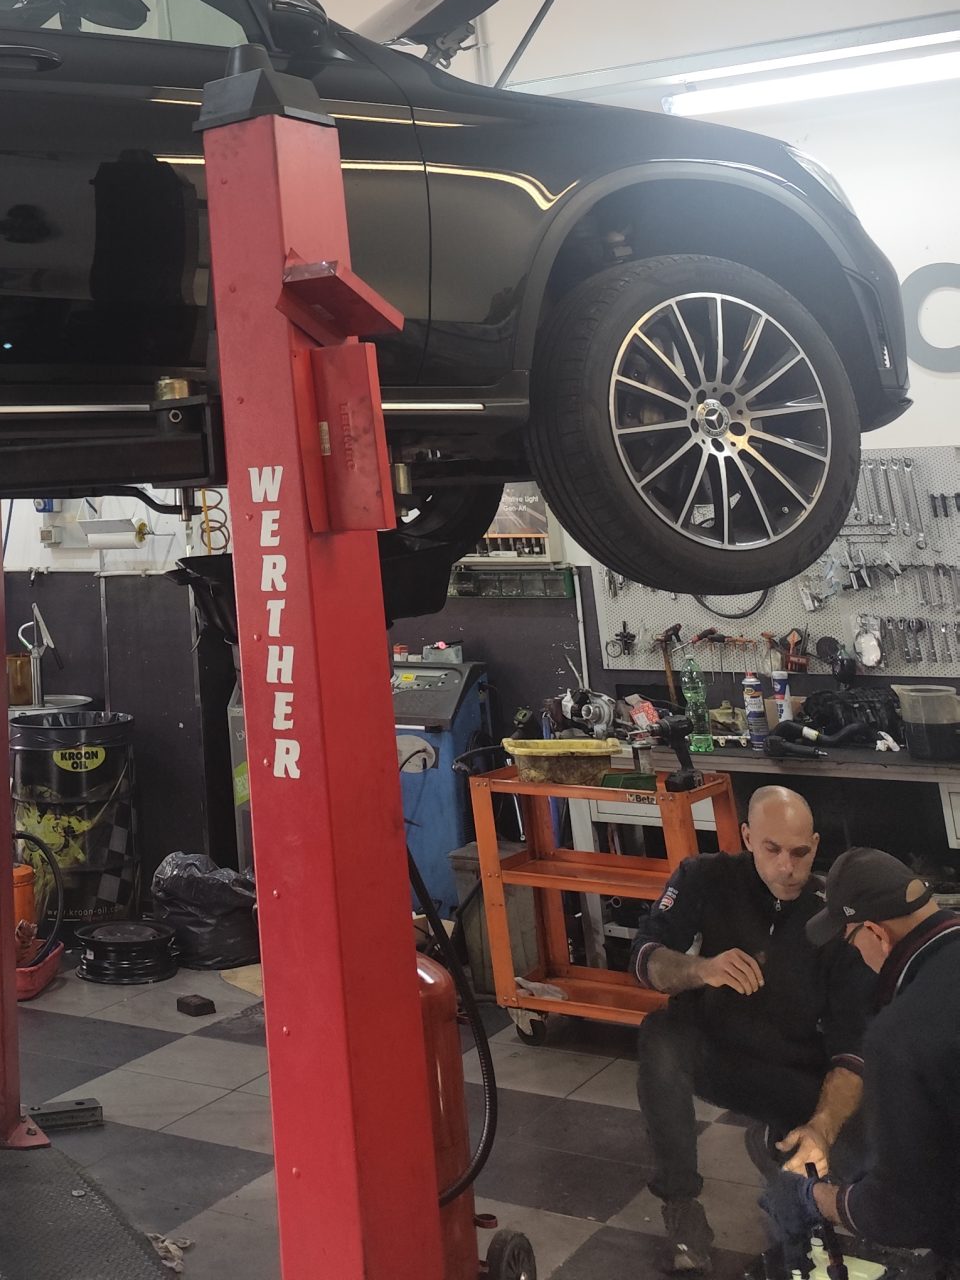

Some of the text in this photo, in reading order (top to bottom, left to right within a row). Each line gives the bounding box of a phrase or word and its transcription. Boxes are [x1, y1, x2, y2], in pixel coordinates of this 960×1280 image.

[248, 466, 300, 778] WERTHER
[60, 750, 99, 761] KROON
[71, 761, 89, 770] OIL
[635, 794, 656, 804] Beta
